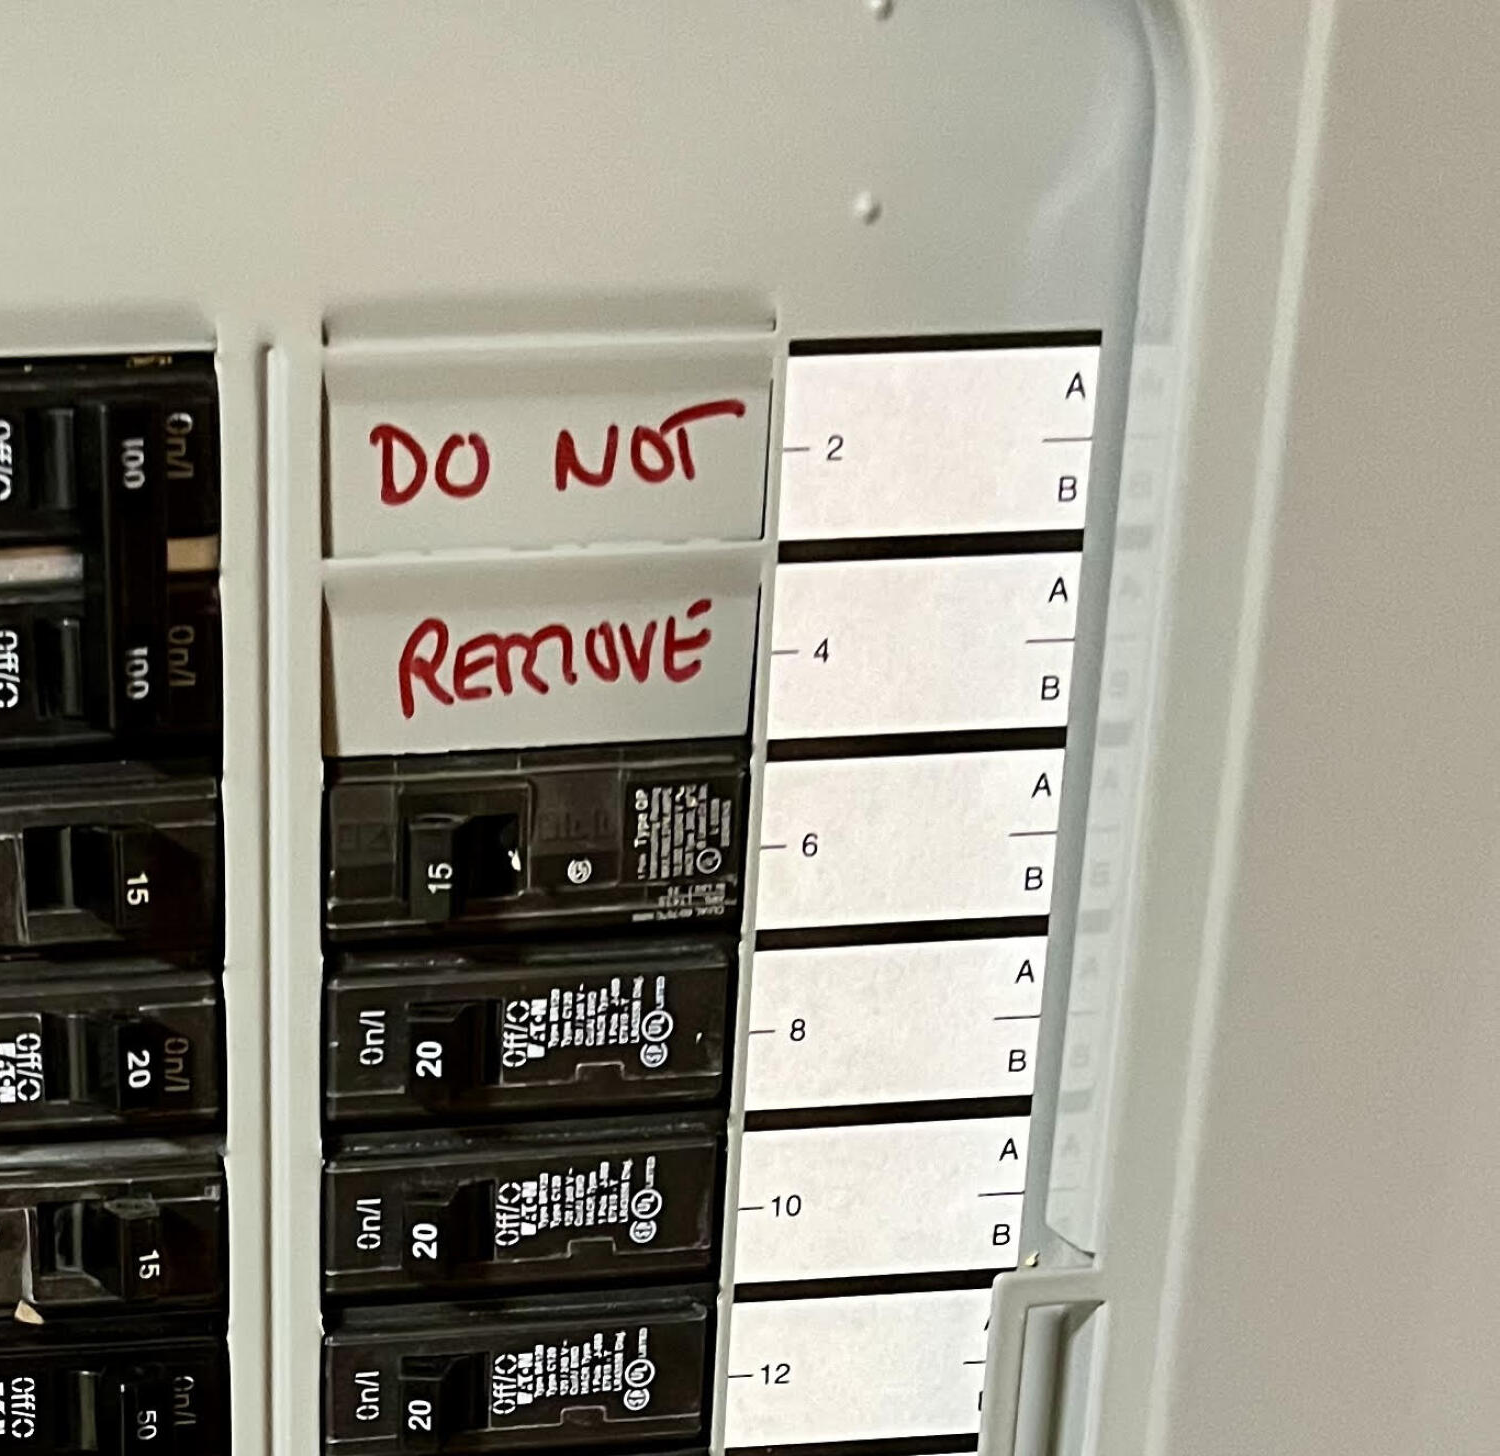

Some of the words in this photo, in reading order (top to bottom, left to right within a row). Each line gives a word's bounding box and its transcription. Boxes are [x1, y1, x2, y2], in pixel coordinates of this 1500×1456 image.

[1066, 372, 1085, 398] A
[370, 422, 490, 506] DO
[555, 399, 745, 491] NOT
[827, 435, 843, 460] 2
[121, 438, 145, 489] 100
[1058, 476, 1077, 502] B
[1049, 577, 1067, 602] A
[399, 598, 712, 719] REMOVE
[814, 638, 828, 662] 4
[125, 647, 149, 699] 100
[1041, 676, 1059, 700] B
[1032, 773, 1051, 797] A
[803, 833, 817, 856] 6
[126, 873, 149, 905] 15
[428, 862, 452, 894] 15
[1025, 867, 1042, 890] B
[1016, 960, 1034, 983] A
[790, 1019, 805, 1041] 8
[128, 1049, 150, 1088] 20
[416, 1040, 442, 1077] 20
[1009, 1050, 1026, 1072] B
[999, 1138, 1018, 1161] A
[772, 1195, 801, 1216] 10
[413, 1223, 437, 1259] 20
[993, 1224, 1010, 1245] B
[138, 1249, 159, 1278] 15
[761, 1364, 790, 1384] 12
[138, 1410, 158, 1440] 50
[408, 1399, 431, 1431] 20
